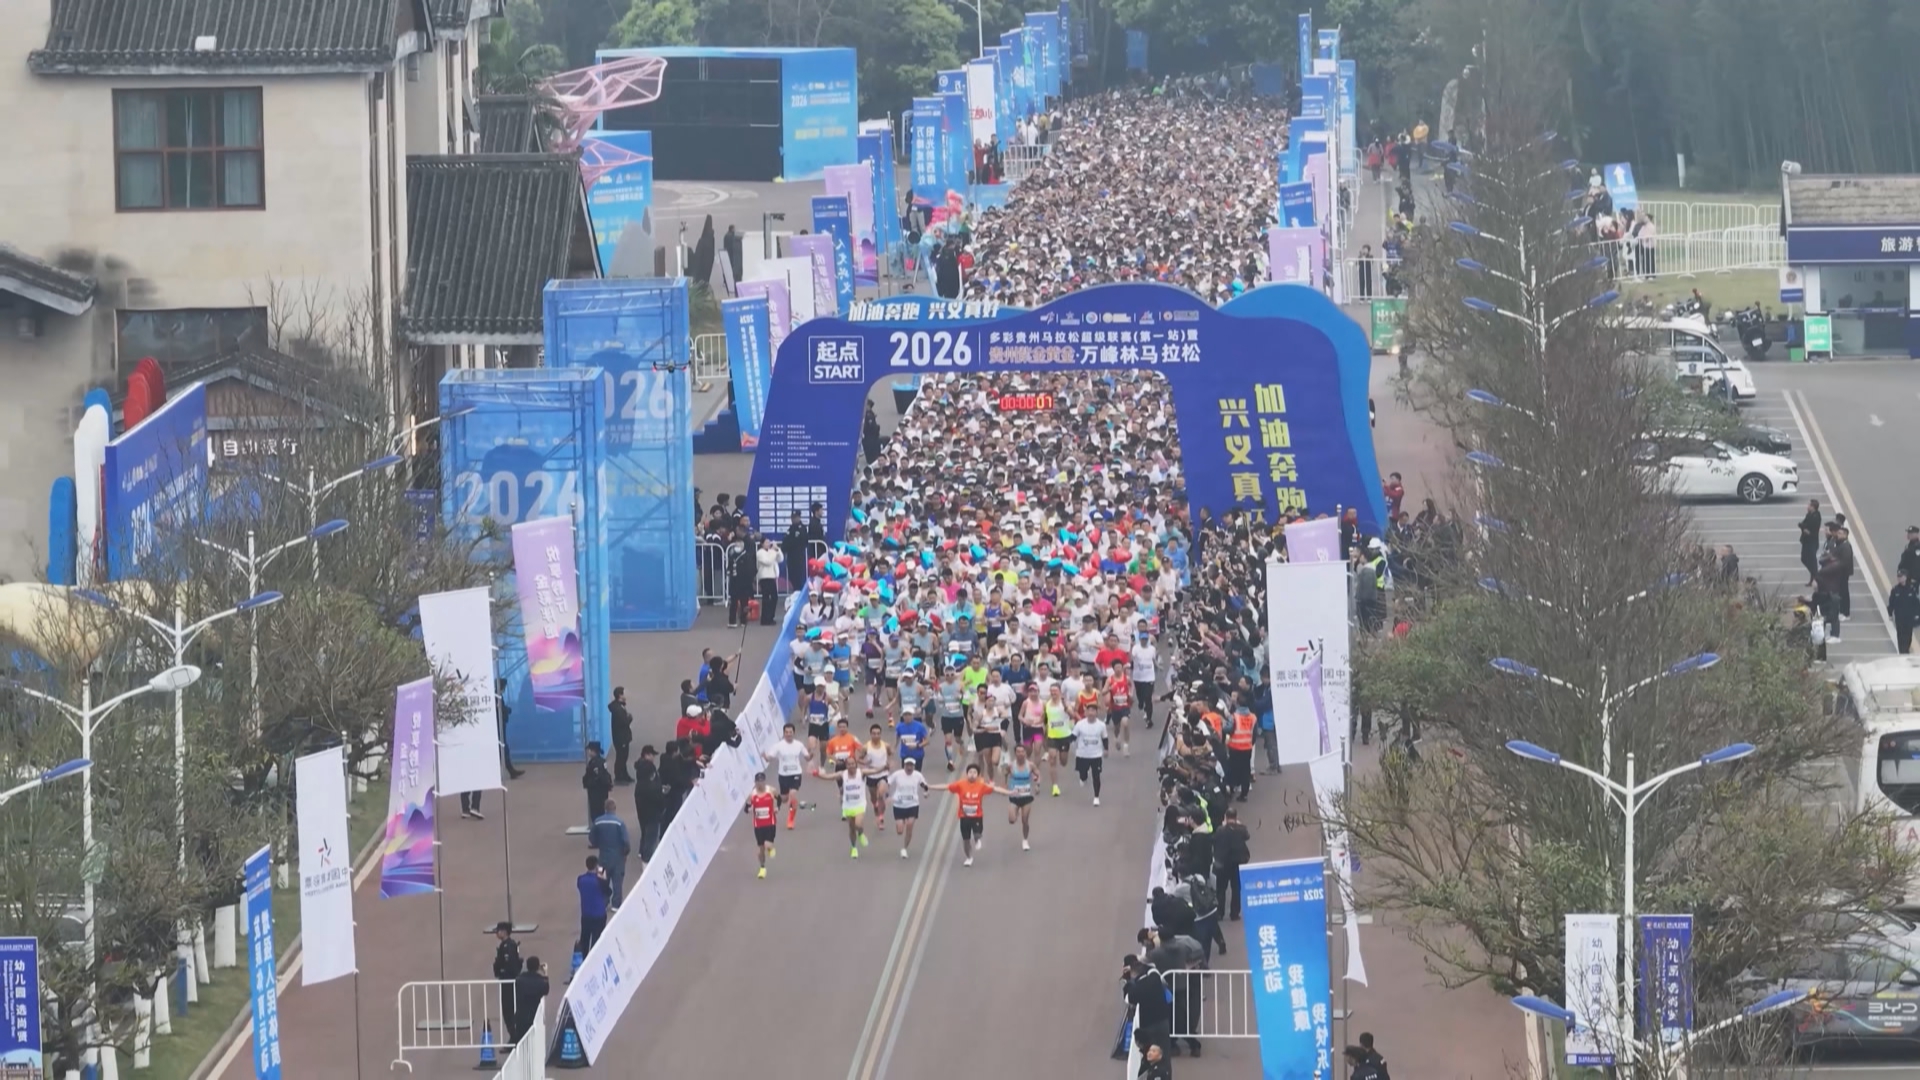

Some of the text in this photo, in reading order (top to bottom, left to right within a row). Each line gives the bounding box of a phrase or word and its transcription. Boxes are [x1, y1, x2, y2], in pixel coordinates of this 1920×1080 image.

[1881, 237, 1920, 252] 旅游
[848, 301, 999, 321] 加油奔跑 兴义真好
[816, 341, 859, 363] 起点
[889, 331, 972, 367] 2026
[814, 365, 861, 379] START
[1255, 383, 1308, 516] 加油奔跑
